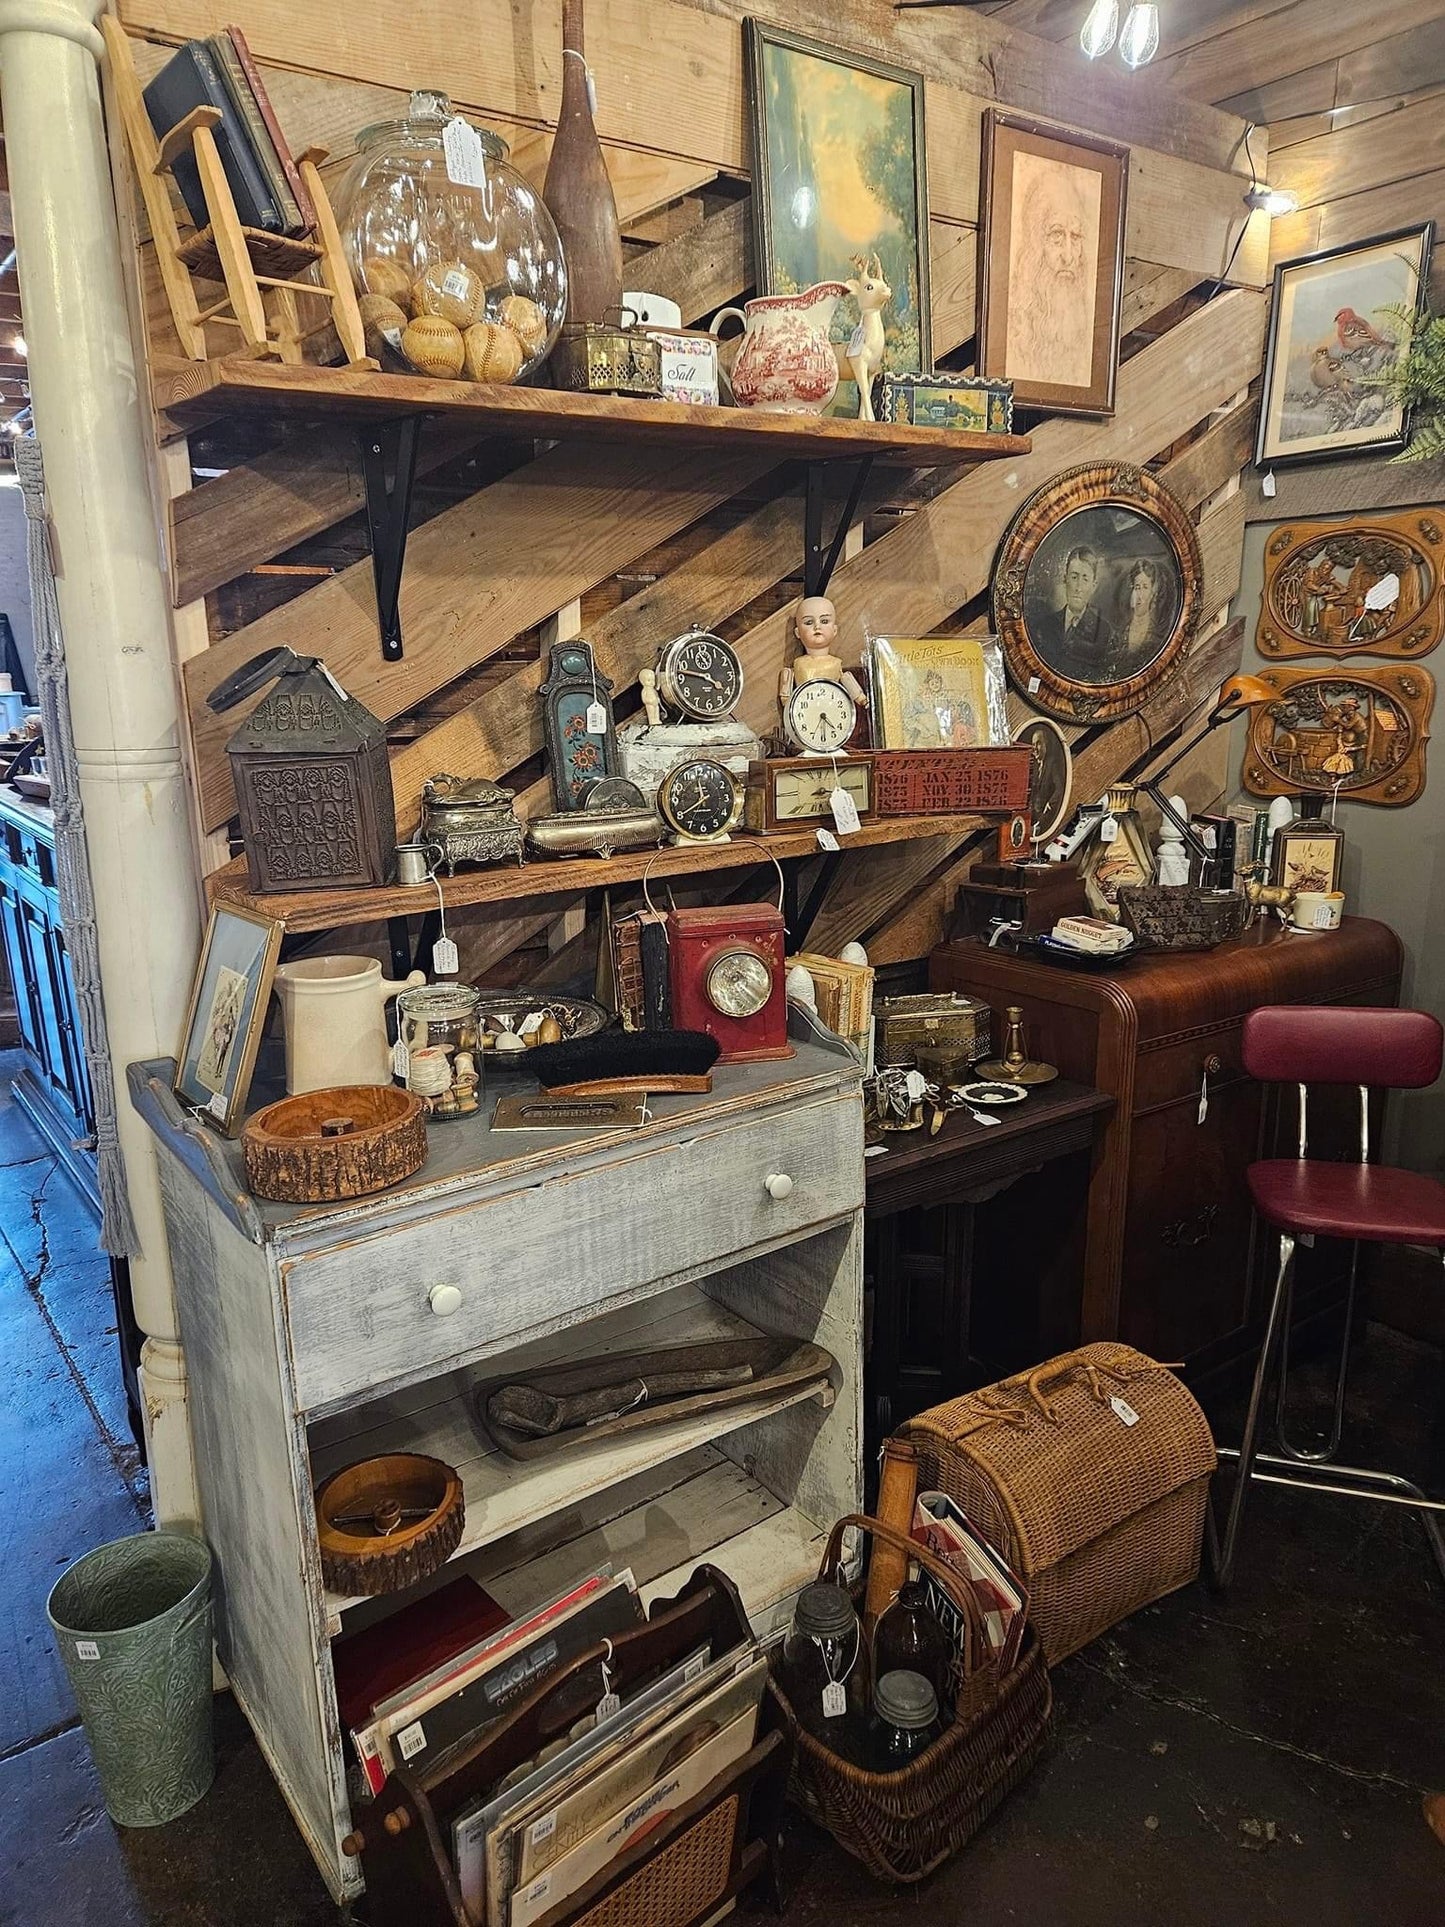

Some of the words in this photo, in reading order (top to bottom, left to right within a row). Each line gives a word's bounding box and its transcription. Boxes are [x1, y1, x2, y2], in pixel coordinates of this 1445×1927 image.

[686, 646, 694, 659] 11
[712, 648, 717, 659] 1
[721, 656, 728, 667] 2
[678, 673, 685, 685] 9
[726, 671, 733, 682] 3
[683, 686, 691, 697] 8
[724, 686, 731, 696] 4
[806, 692, 814, 700] 11
[693, 697, 700, 707] 7
[705, 699, 713, 710] 6
[716, 696, 723, 706] 5
[800, 701, 809, 709] 10
[837, 700, 843, 709] 2
[840, 711, 847, 719] 3
[801, 723, 808, 732] 8
[836, 722, 843, 731] 4
[809, 732, 815, 740] 7
[830, 730, 837, 738] 5
[977, 769, 1008, 781] 1876
[719, 780, 726, 789] 2
[723, 794, 730, 803] 3
[676, 811, 684, 820] 8
[720, 808, 728, 817] 4
[687, 820, 693, 830] 7
[712, 819, 719, 828] 5
[700, 824, 707, 833] 6
[1060, 921, 1081, 933] GOLDEN
[1081, 928, 1103, 939] NUGGET
